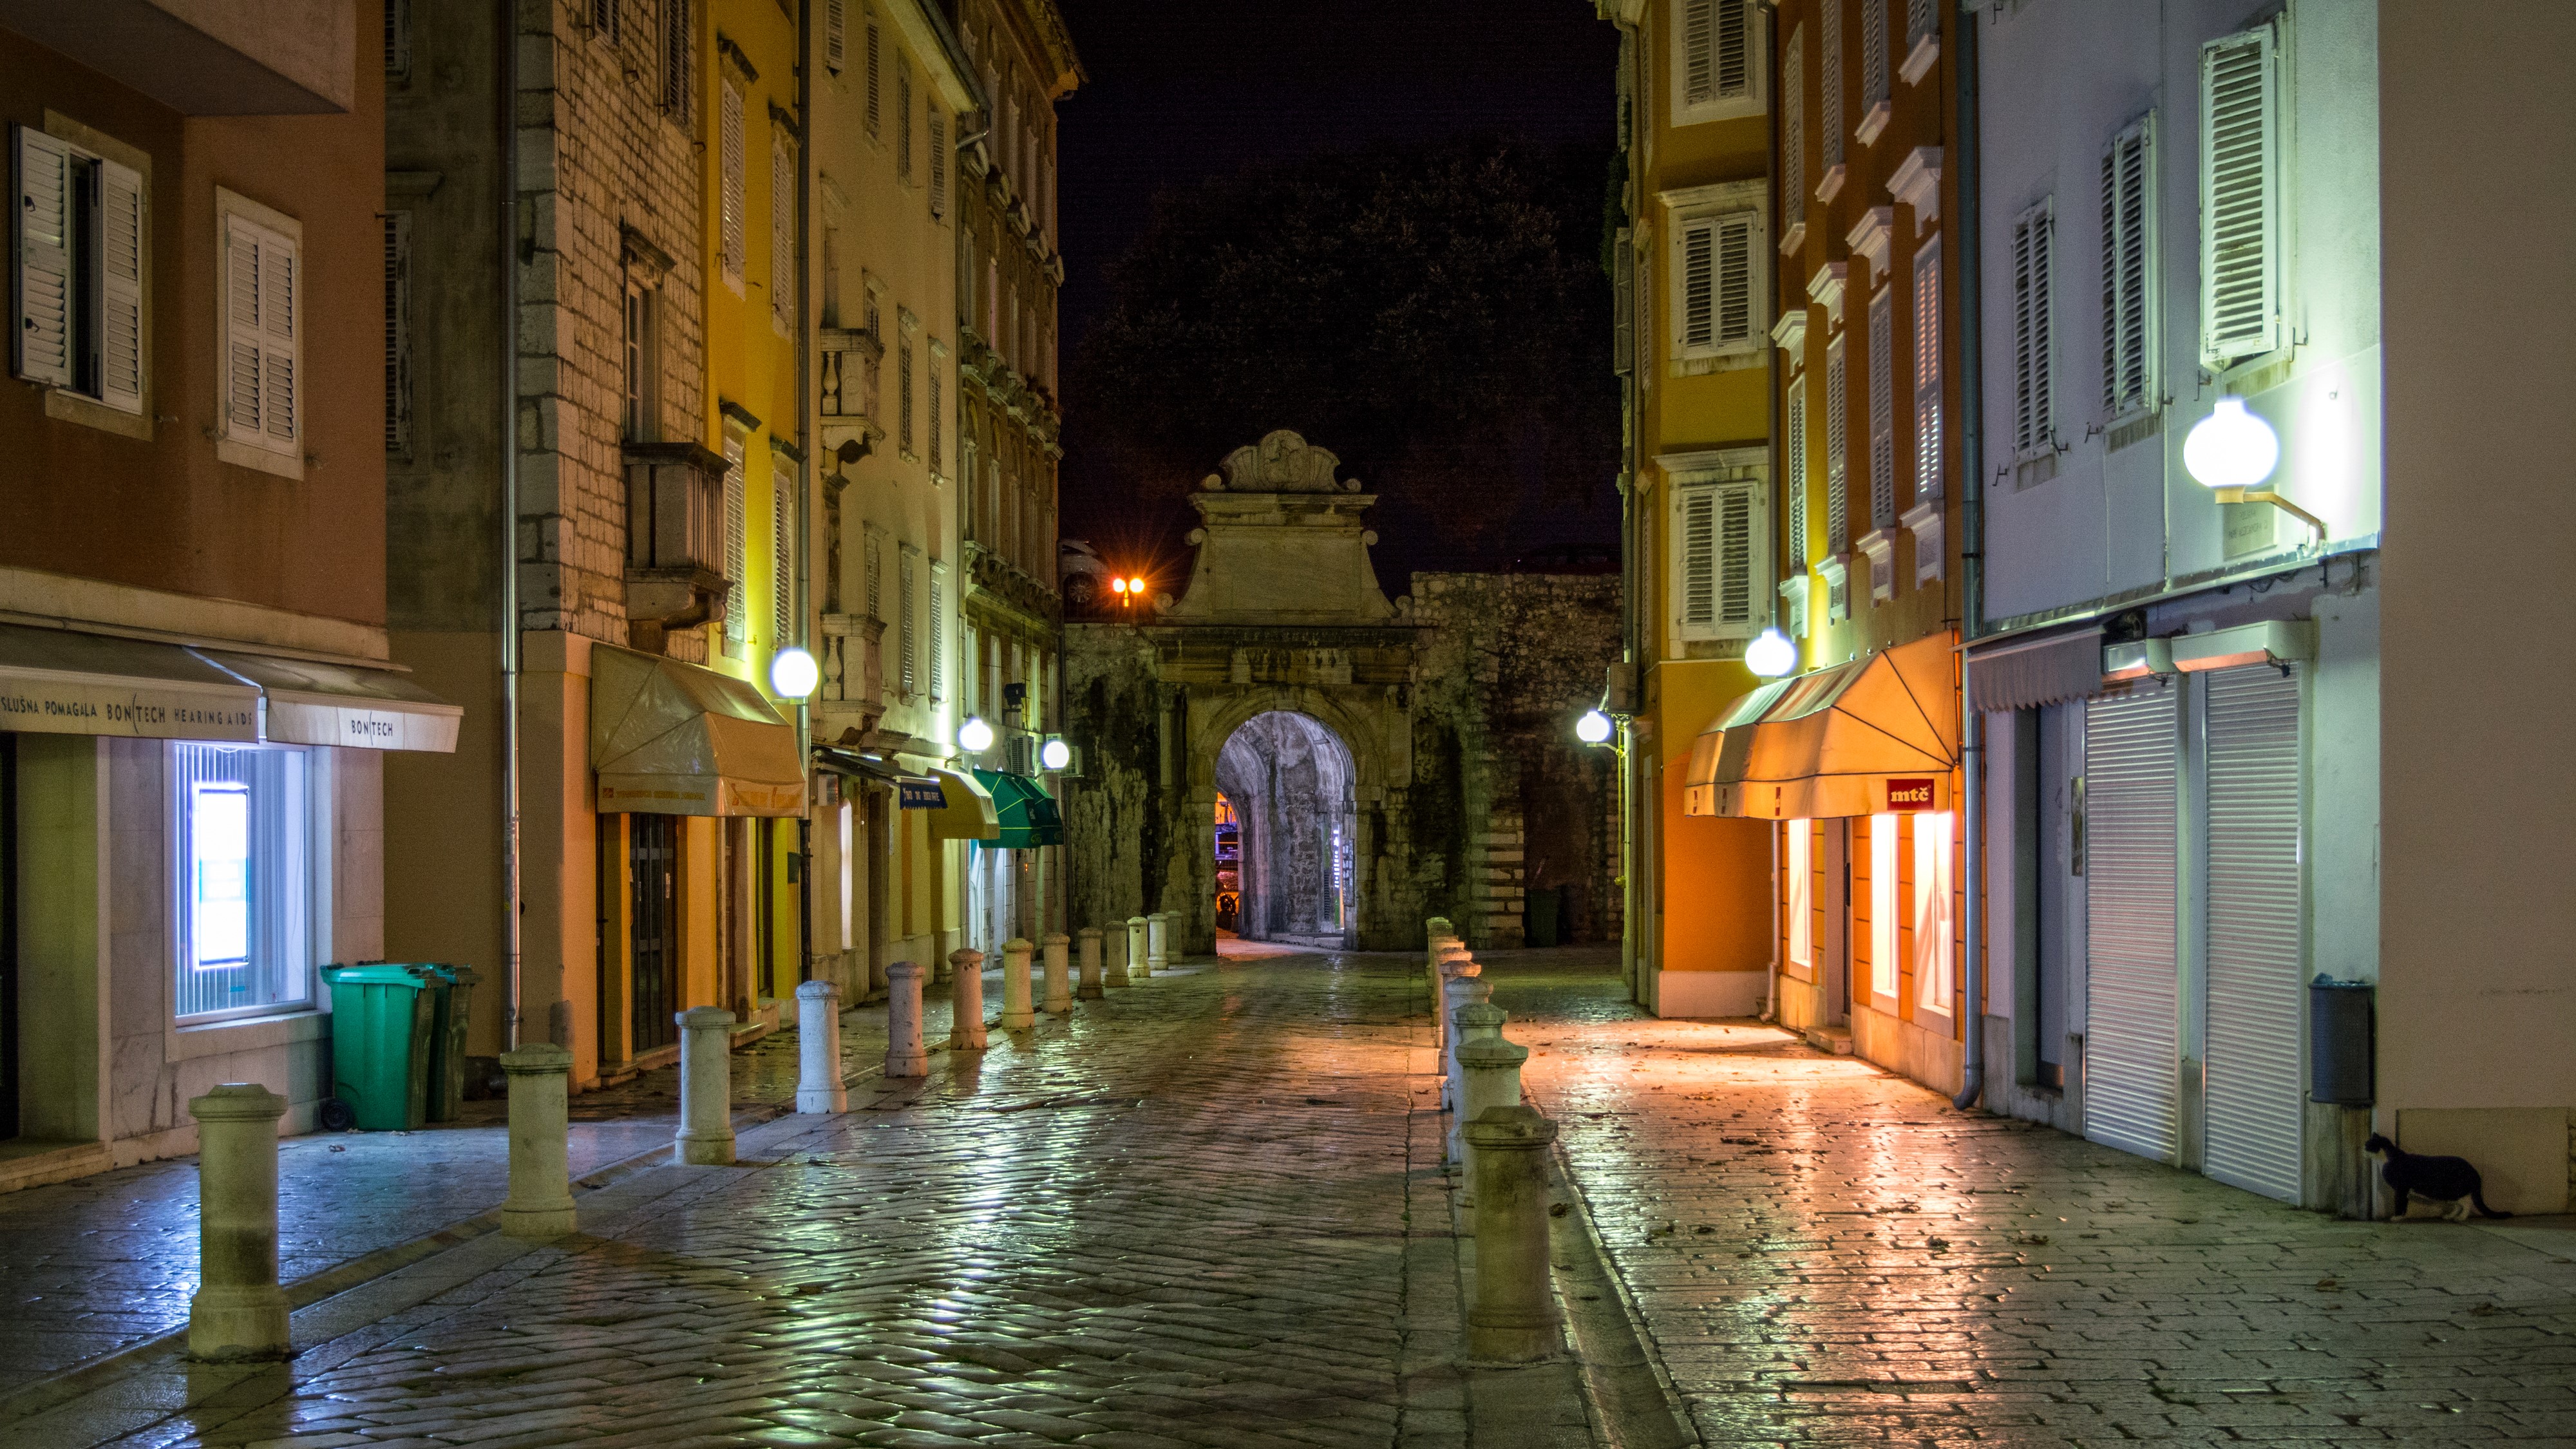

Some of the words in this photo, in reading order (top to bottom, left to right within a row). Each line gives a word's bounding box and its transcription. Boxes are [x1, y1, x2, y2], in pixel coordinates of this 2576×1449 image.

[1, 696, 39, 714] SLUŠNA
[45, 700, 97, 717] POMAGALA
[1891, 787, 1929, 802] mtč
